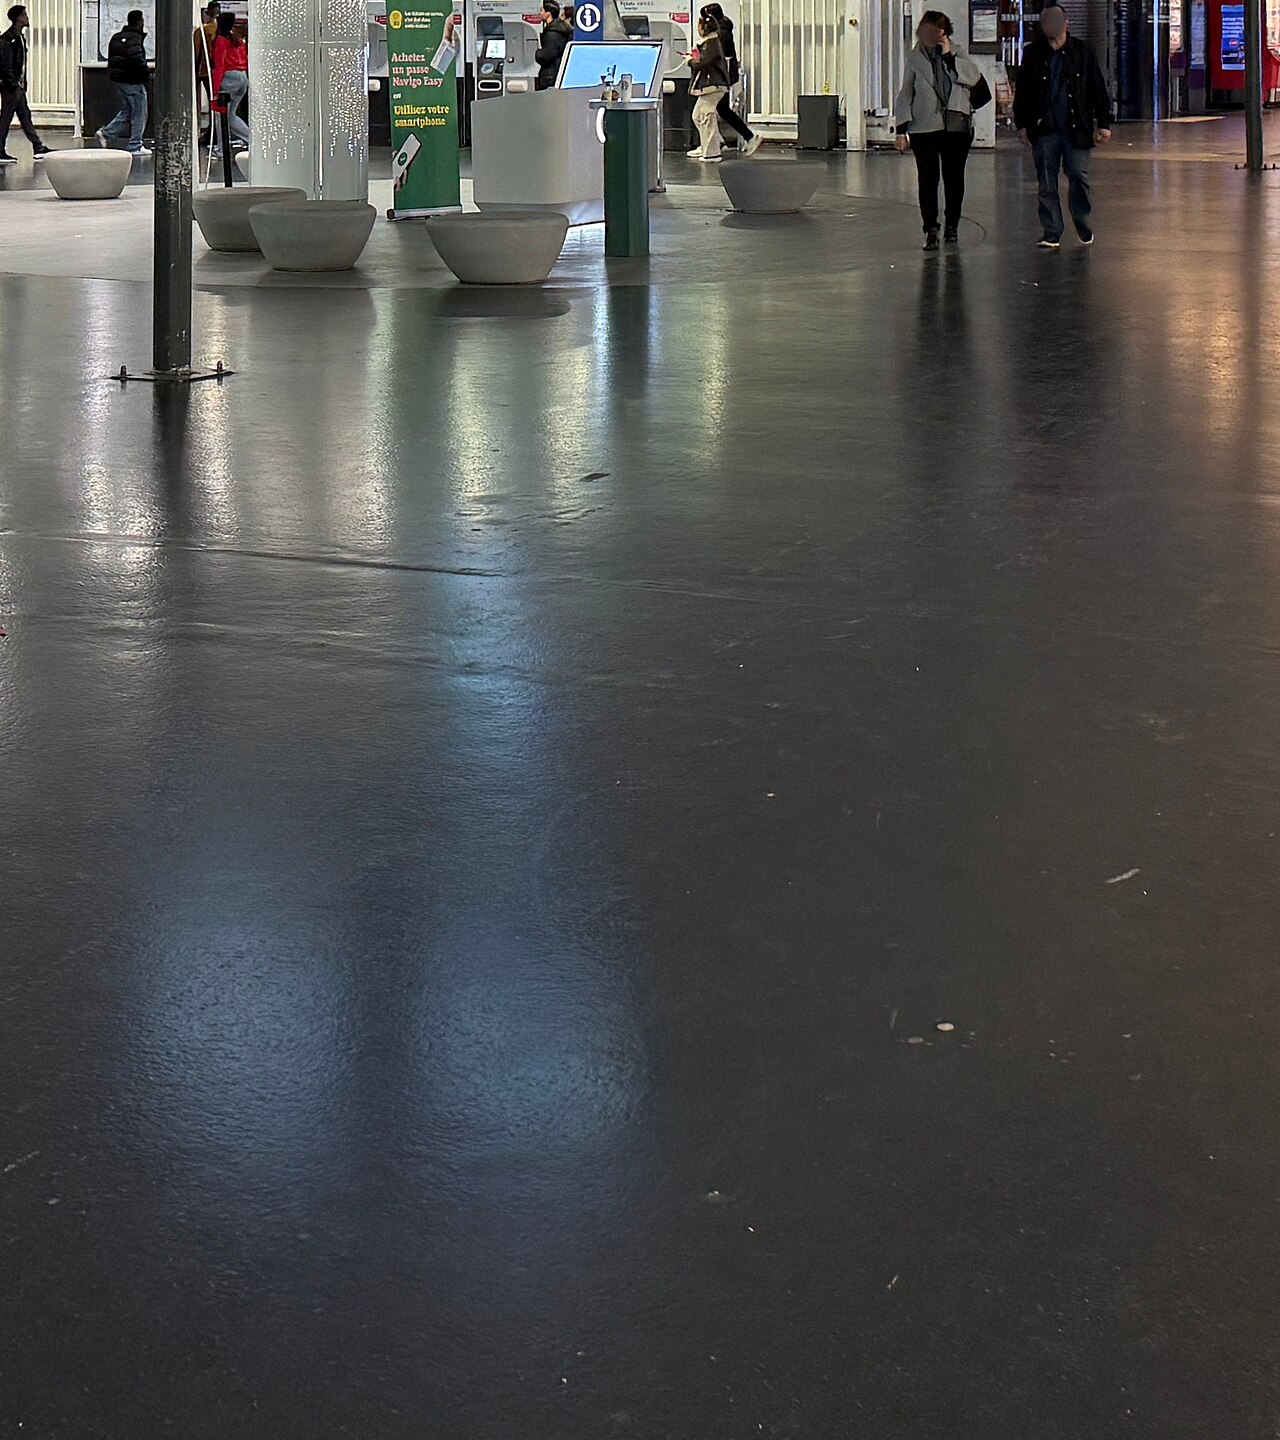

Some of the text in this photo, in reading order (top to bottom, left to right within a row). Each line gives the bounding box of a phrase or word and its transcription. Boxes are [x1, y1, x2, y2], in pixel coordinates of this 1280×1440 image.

[391, 52, 425, 62] Achetez
[392, 66, 429, 76] un passe
[393, 76, 443, 88] Navigo Easy
[393, 105, 449, 115] Utilisez votre
[395, 117, 446, 128] smartphone
